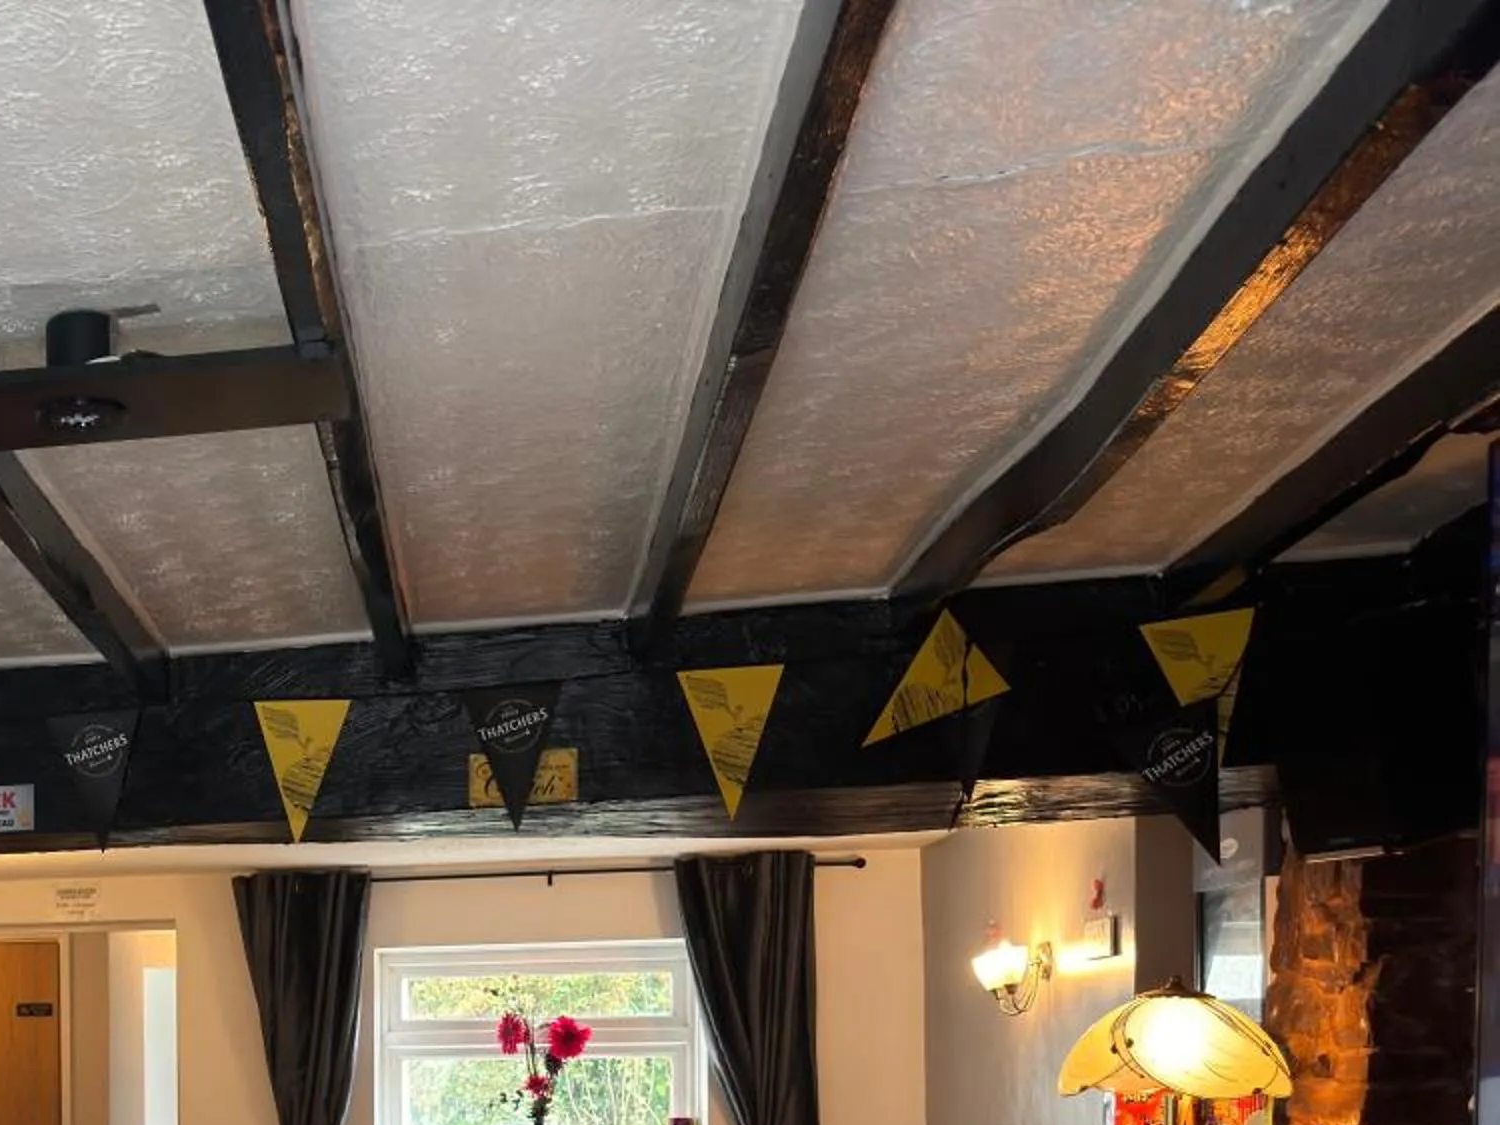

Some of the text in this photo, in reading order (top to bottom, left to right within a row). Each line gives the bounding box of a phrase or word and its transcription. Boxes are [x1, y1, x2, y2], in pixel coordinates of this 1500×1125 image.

[477, 706, 549, 741] THATCHERS
[63, 732, 128, 766] THATCHERS
[1141, 730, 1213, 783] THATCHERS
